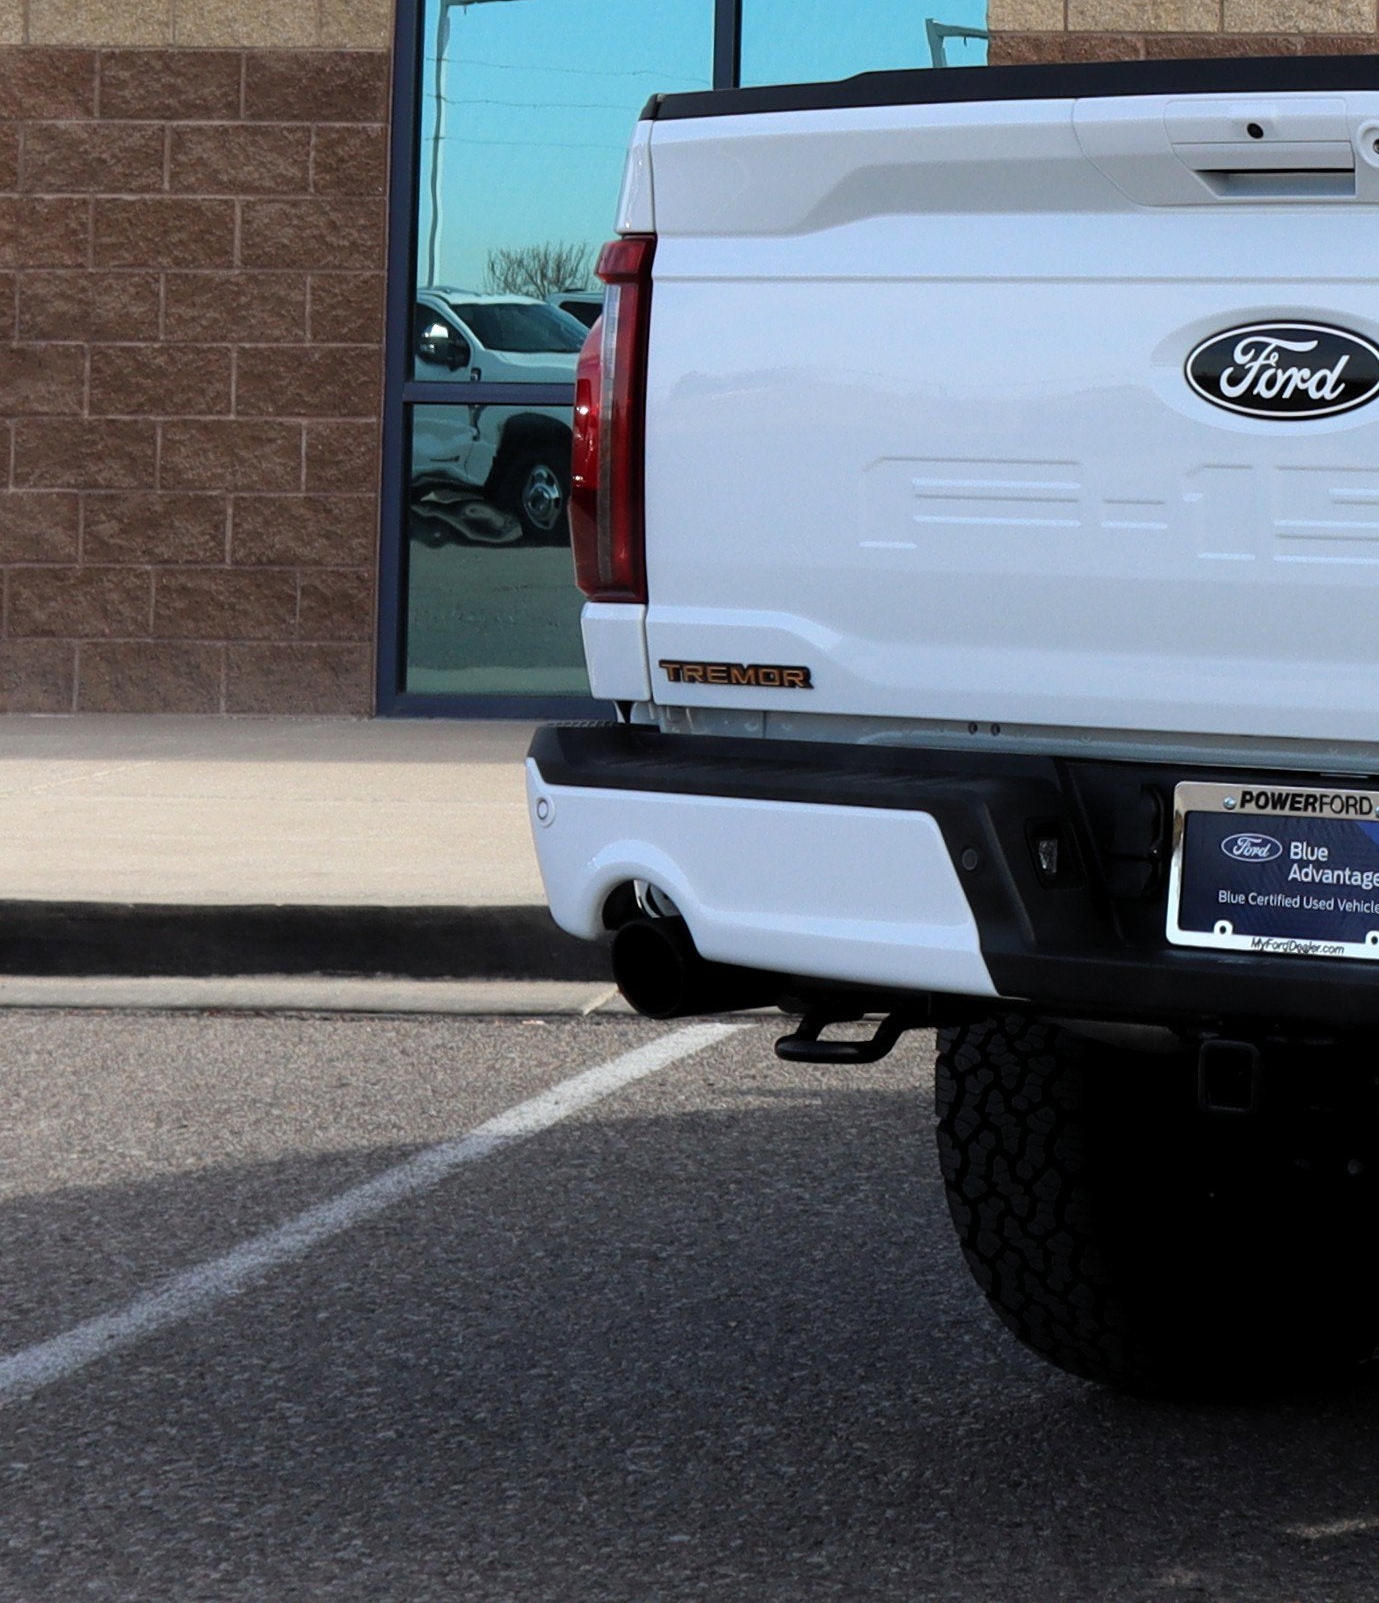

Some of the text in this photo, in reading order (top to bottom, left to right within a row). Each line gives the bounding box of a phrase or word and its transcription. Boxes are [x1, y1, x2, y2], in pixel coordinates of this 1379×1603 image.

[1219, 335, 1351, 401] Ford
[658, 659, 814, 690] TREMOR
[1239, 790, 1374, 816] POWERFORD
[1232, 836, 1272, 858] Ford
[1289, 841, 1329, 862] Blue
[1218, 890, 1246, 905] Blue
[1248, 892, 1300, 909] Certified
[1302, 897, 1335, 912] Used
